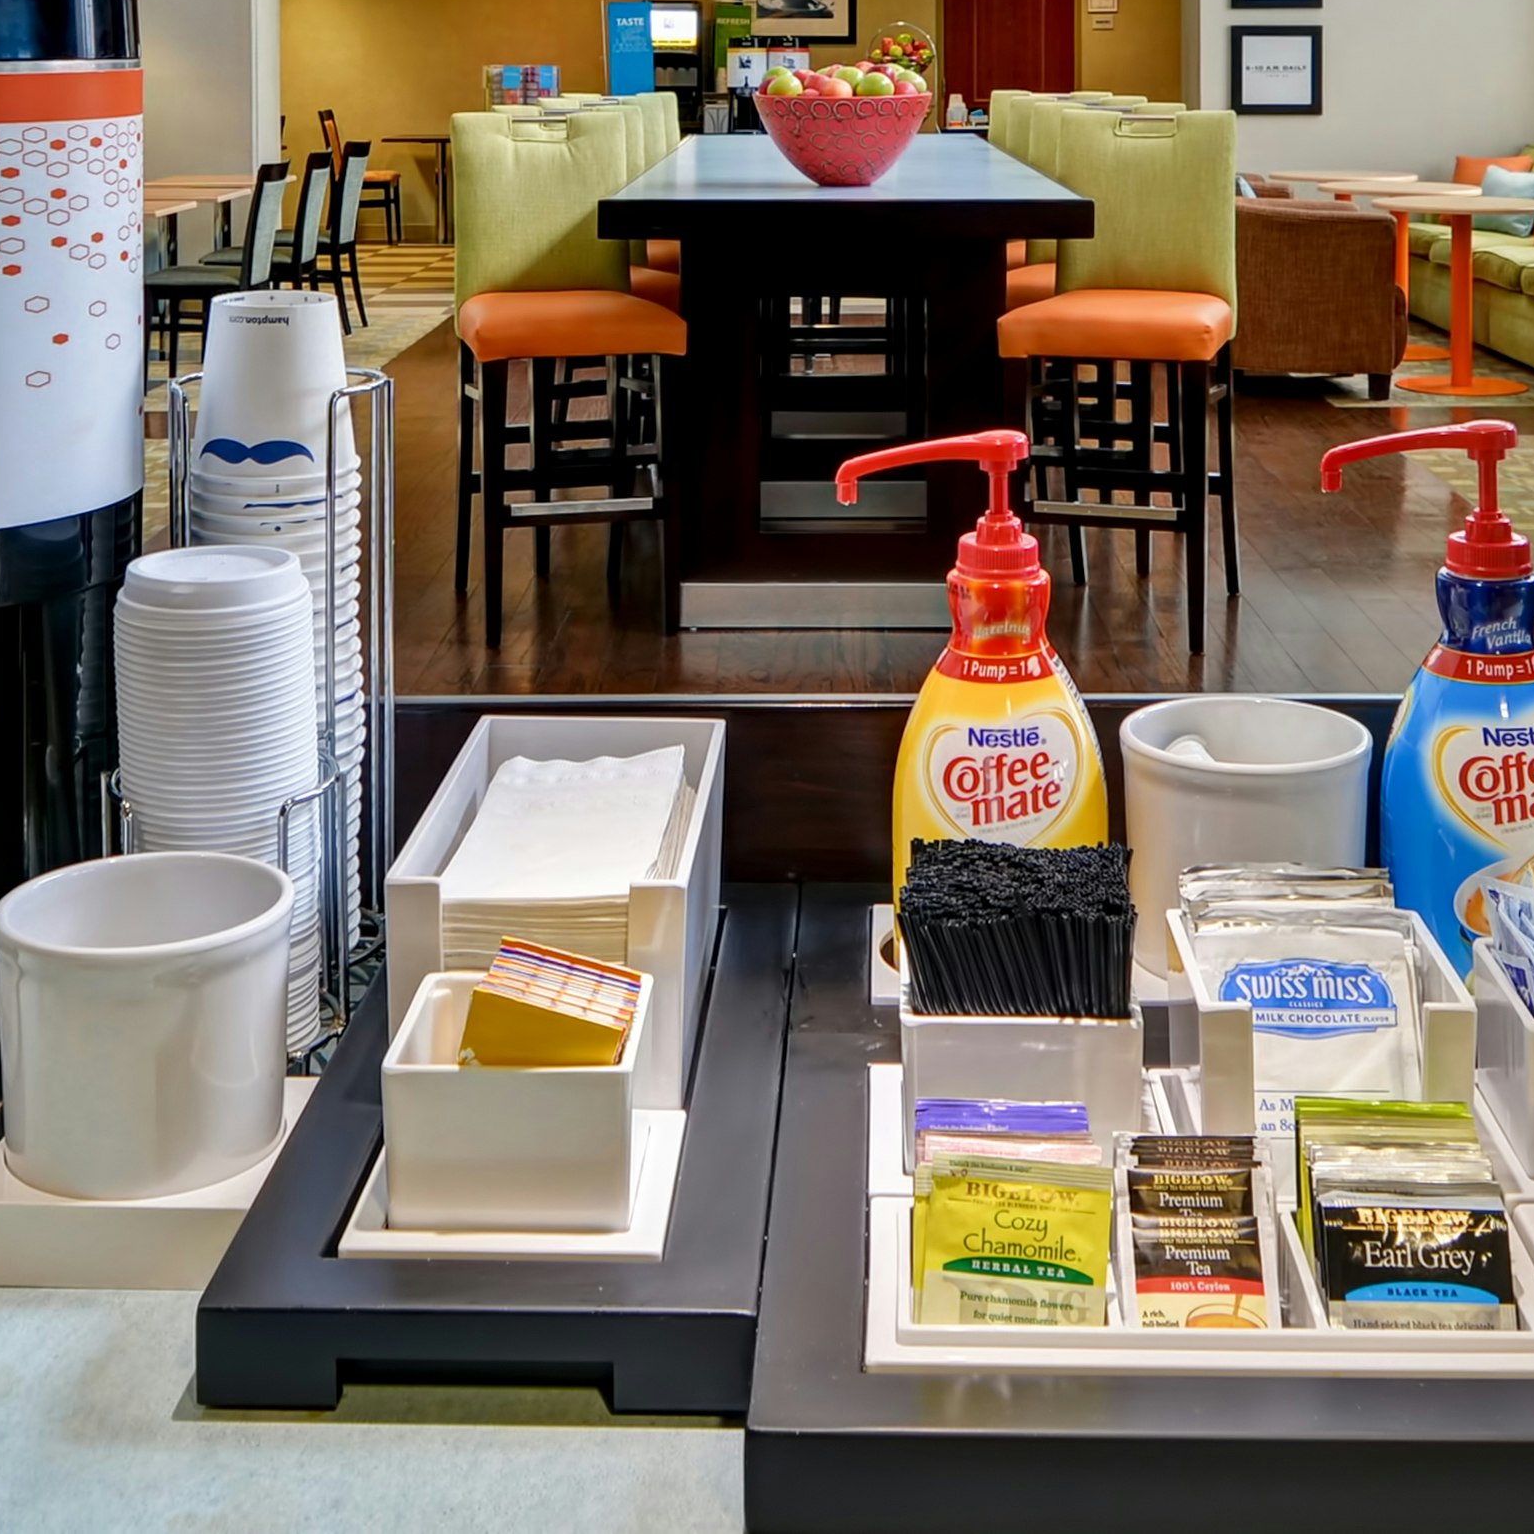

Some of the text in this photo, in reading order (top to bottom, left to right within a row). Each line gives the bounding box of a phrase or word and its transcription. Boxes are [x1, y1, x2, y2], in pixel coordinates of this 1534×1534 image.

[616, 17, 644, 26] TASTE
[717, 17, 750, 25] REFRESH
[1471, 617, 1517, 640] French
[1486, 630, 1532, 650] Vanilla
[963, 660, 969, 675] 1
[971, 661, 1007, 681] Pump
[1467, 659, 1472, 675] 1
[1476, 660, 1514, 680] Pump
[971, 779, 1061, 826] mate
[1255, 1013, 1285, 1023] MILK
[1288, 1013, 1360, 1023] CHOCOLATE
[1259, 1098, 1276, 1111] As
[1260, 1123, 1276, 1131] an
[1153, 1175, 1229, 1185] BIGELOW
[966, 1181, 1078, 1205] BIGELOW
[1159, 1192, 1223, 1208] Premium
[1159, 1218, 1233, 1228] BIGELOW
[1356, 1207, 1471, 1226] BIGELOW
[994, 1210, 1047, 1242] Cozy
[1165, 1245, 1230, 1261] Premium
[1364, 1241, 1475, 1276] Earl Grey
[972, 1259, 1066, 1278] HERBAL TEA
[1186, 1261, 1212, 1276] Tea
[1197, 1281, 1231, 1292] Ceylon
[1388, 1288, 1458, 1297] BLACK TEA
[960, 1290, 1074, 1310] Pure chamomile flowers
[973, 1309, 987, 1319] for
[989, 1312, 1013, 1323] quiet
